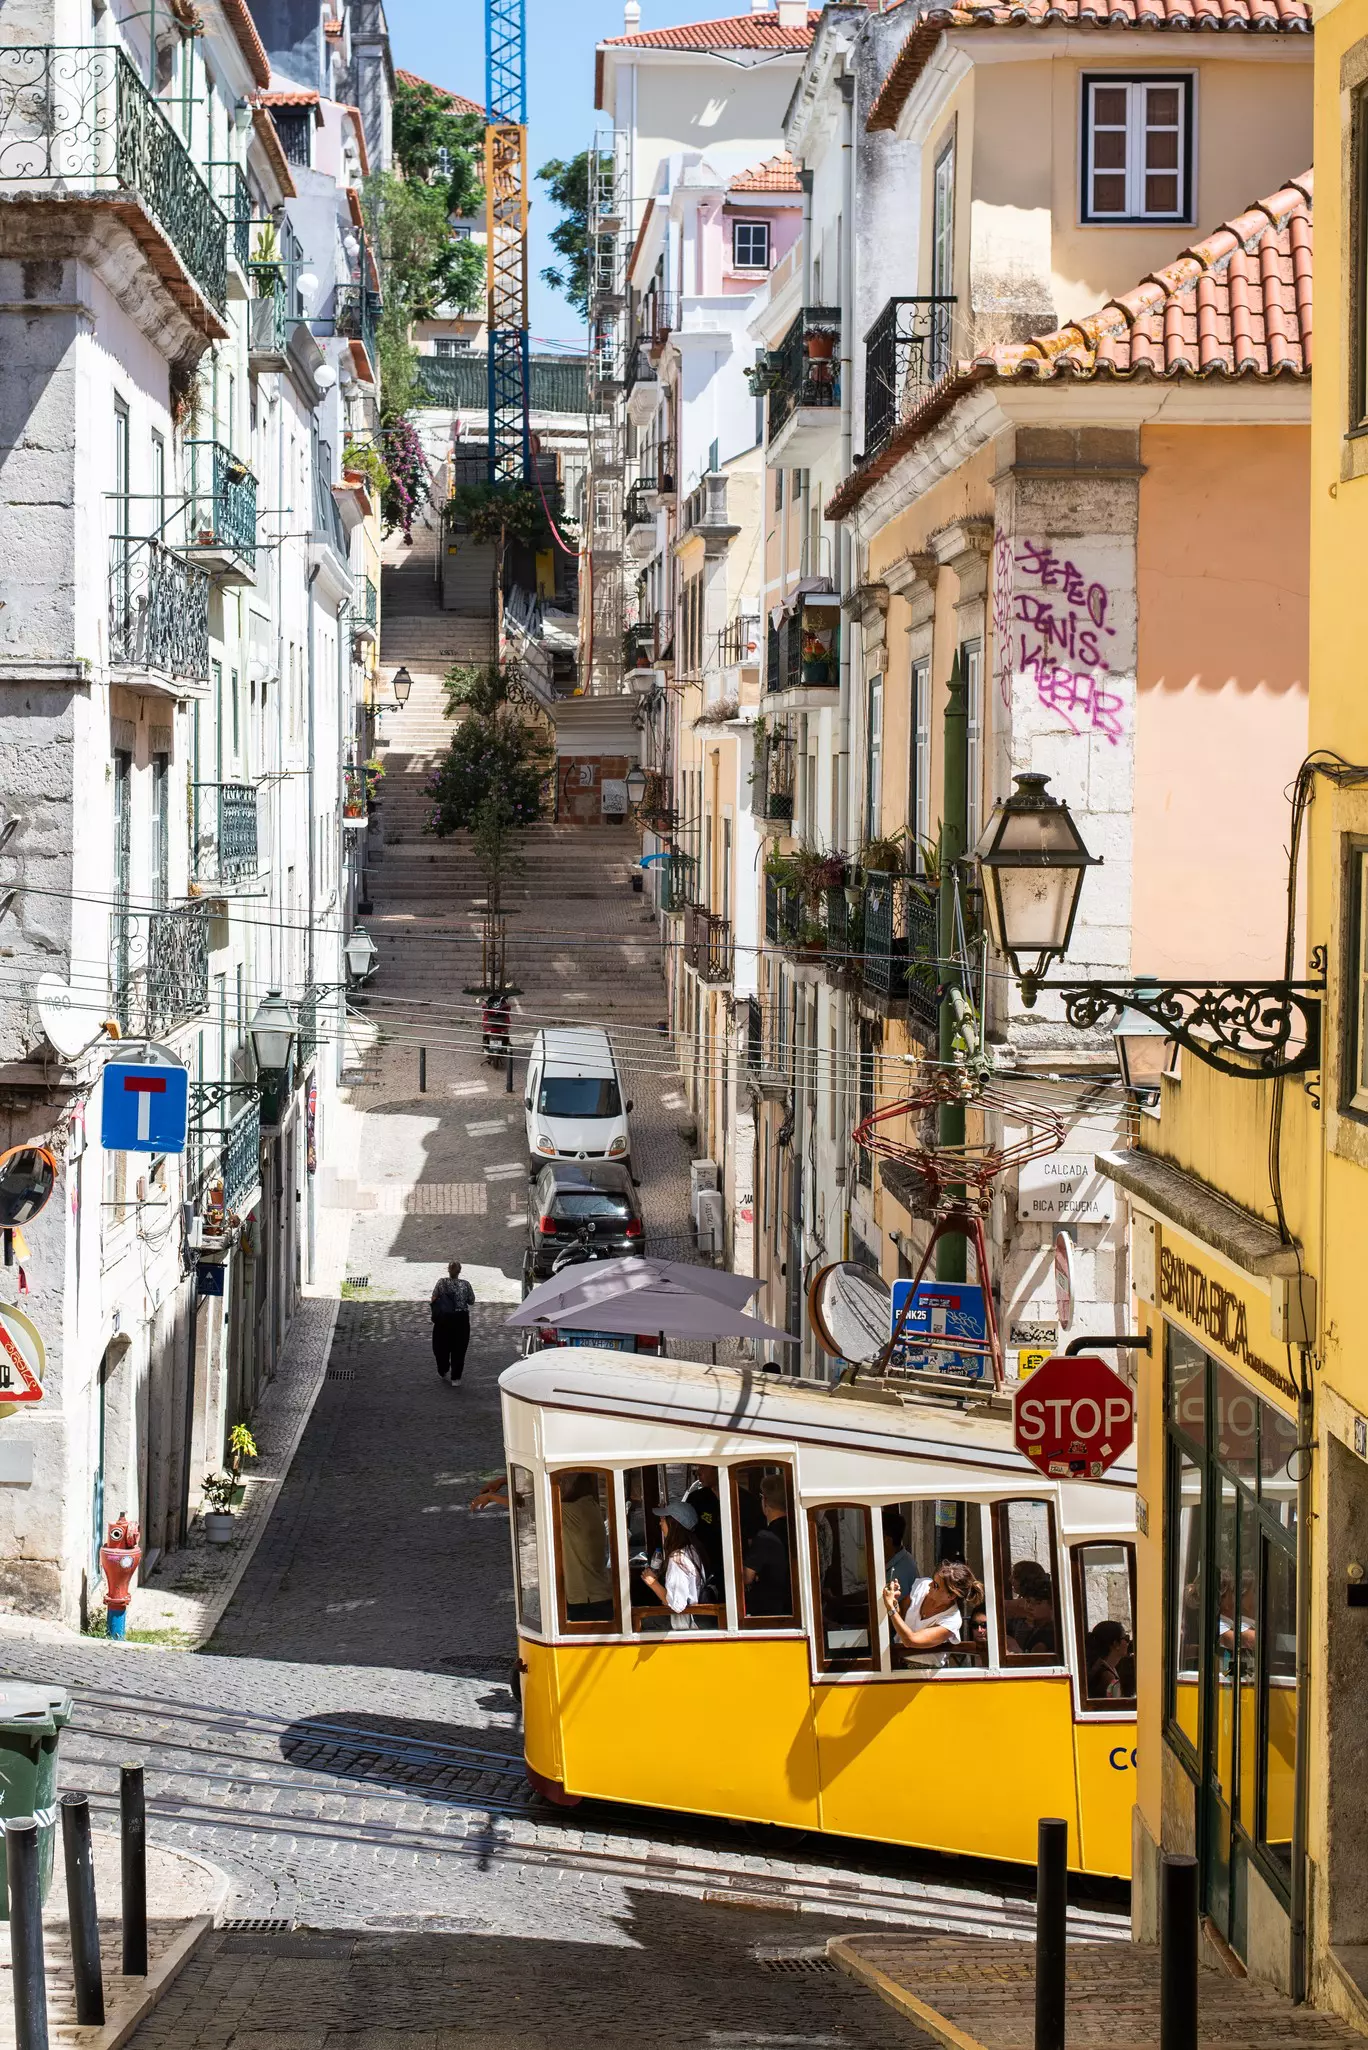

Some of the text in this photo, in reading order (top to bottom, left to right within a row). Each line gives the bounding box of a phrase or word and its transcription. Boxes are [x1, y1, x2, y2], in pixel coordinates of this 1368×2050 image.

[1060, 1182, 1073, 1193] DA
[1033, 1200, 1099, 1212] BICA PEQUENA
[1160, 1246, 1249, 1364] SANTA BICA
[895, 1309, 927, 1320] FNK25
[1019, 1398, 1131, 1440] STOP
